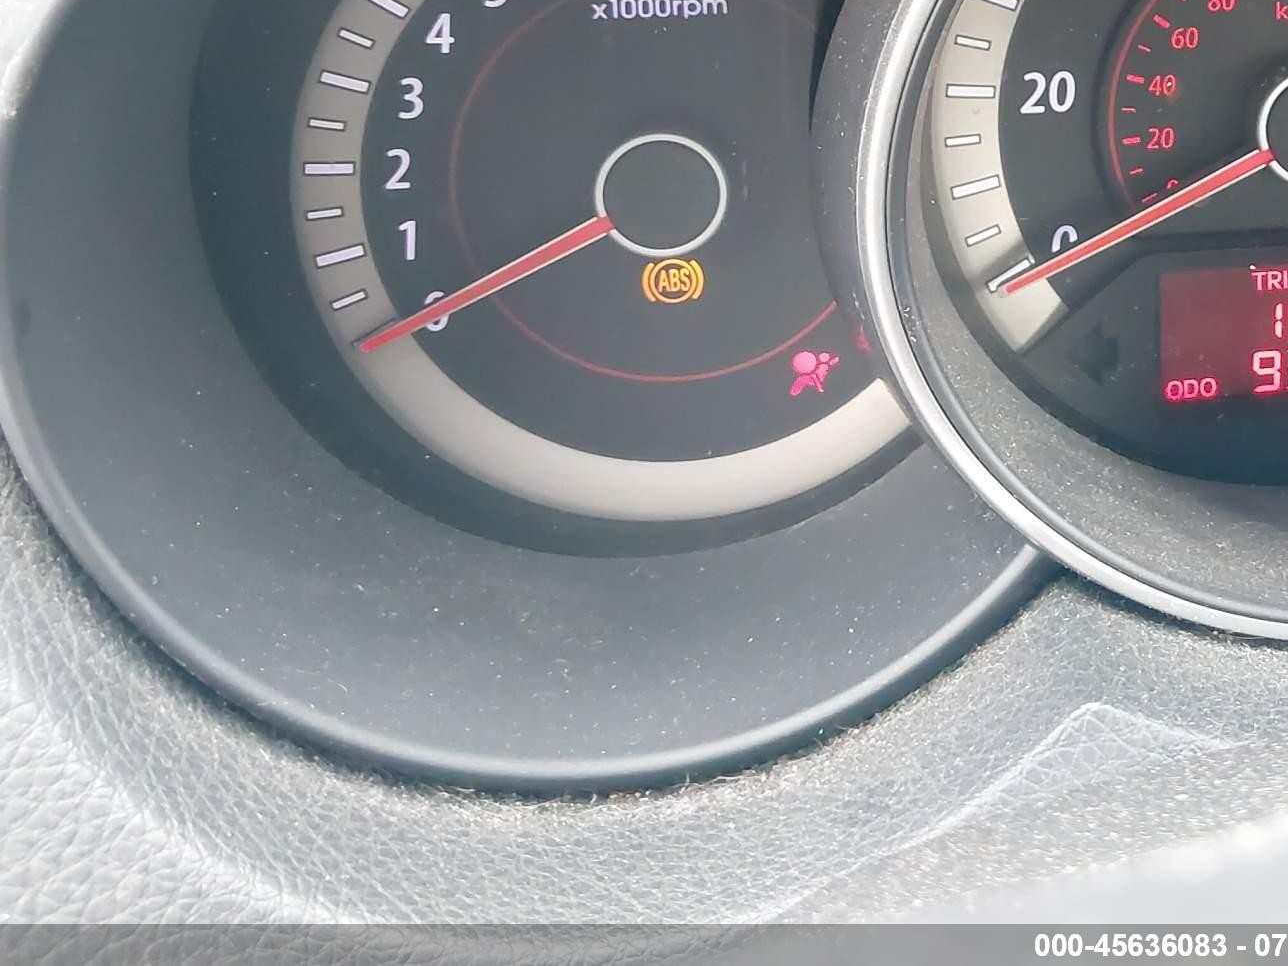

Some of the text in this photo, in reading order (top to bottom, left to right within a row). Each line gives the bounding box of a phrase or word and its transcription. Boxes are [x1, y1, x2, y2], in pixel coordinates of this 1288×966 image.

[425, 13, 455, 54] 4
[1171, 27, 1199, 49] 60
[398, 78, 424, 119] 3
[1019, 71, 1076, 114] 20
[1149, 75, 1176, 96] 40
[1147, 128, 1174, 149] 20
[385, 149, 412, 190] 2
[398, 220, 416, 260] 1
[656, 268, 691, 292] ABS
[1165, 378, 1217, 400] ODO
